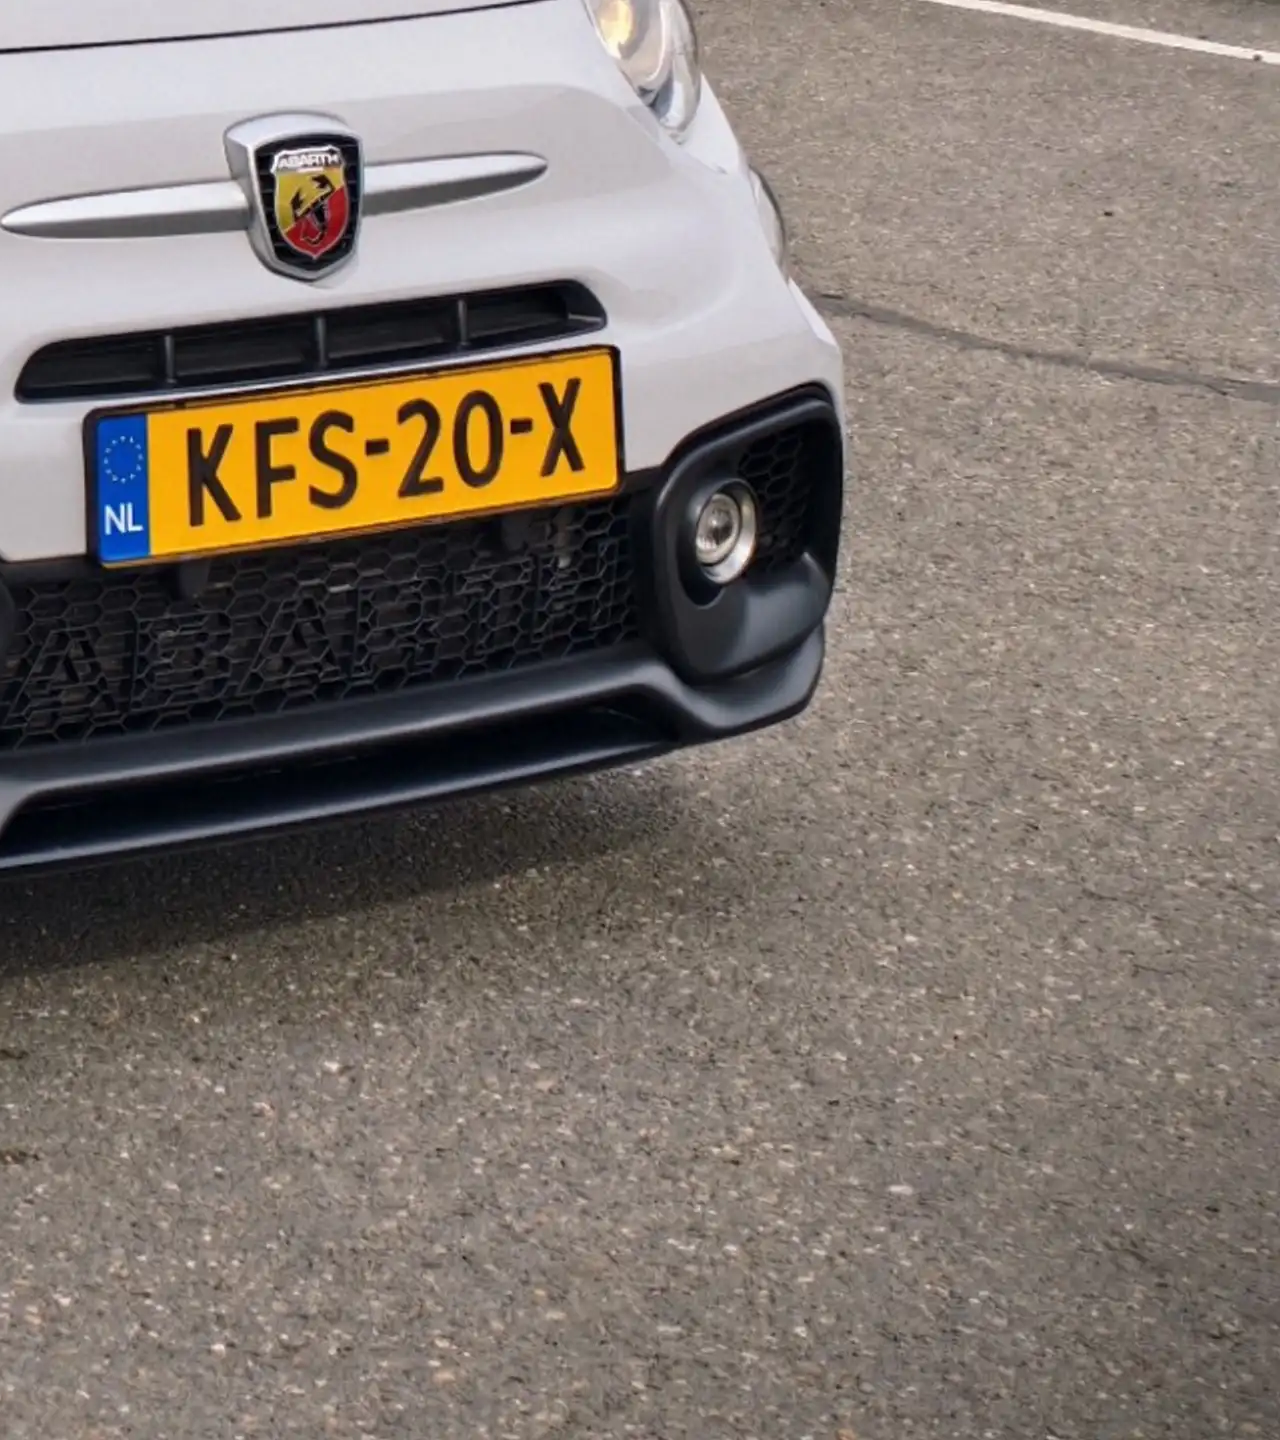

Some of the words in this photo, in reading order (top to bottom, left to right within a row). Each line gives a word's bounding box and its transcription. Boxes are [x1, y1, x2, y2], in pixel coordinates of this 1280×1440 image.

[278, 152, 341, 169] ABARTH
[186, 377, 585, 527] KFS-20-X
[104, 503, 144, 536] NL
